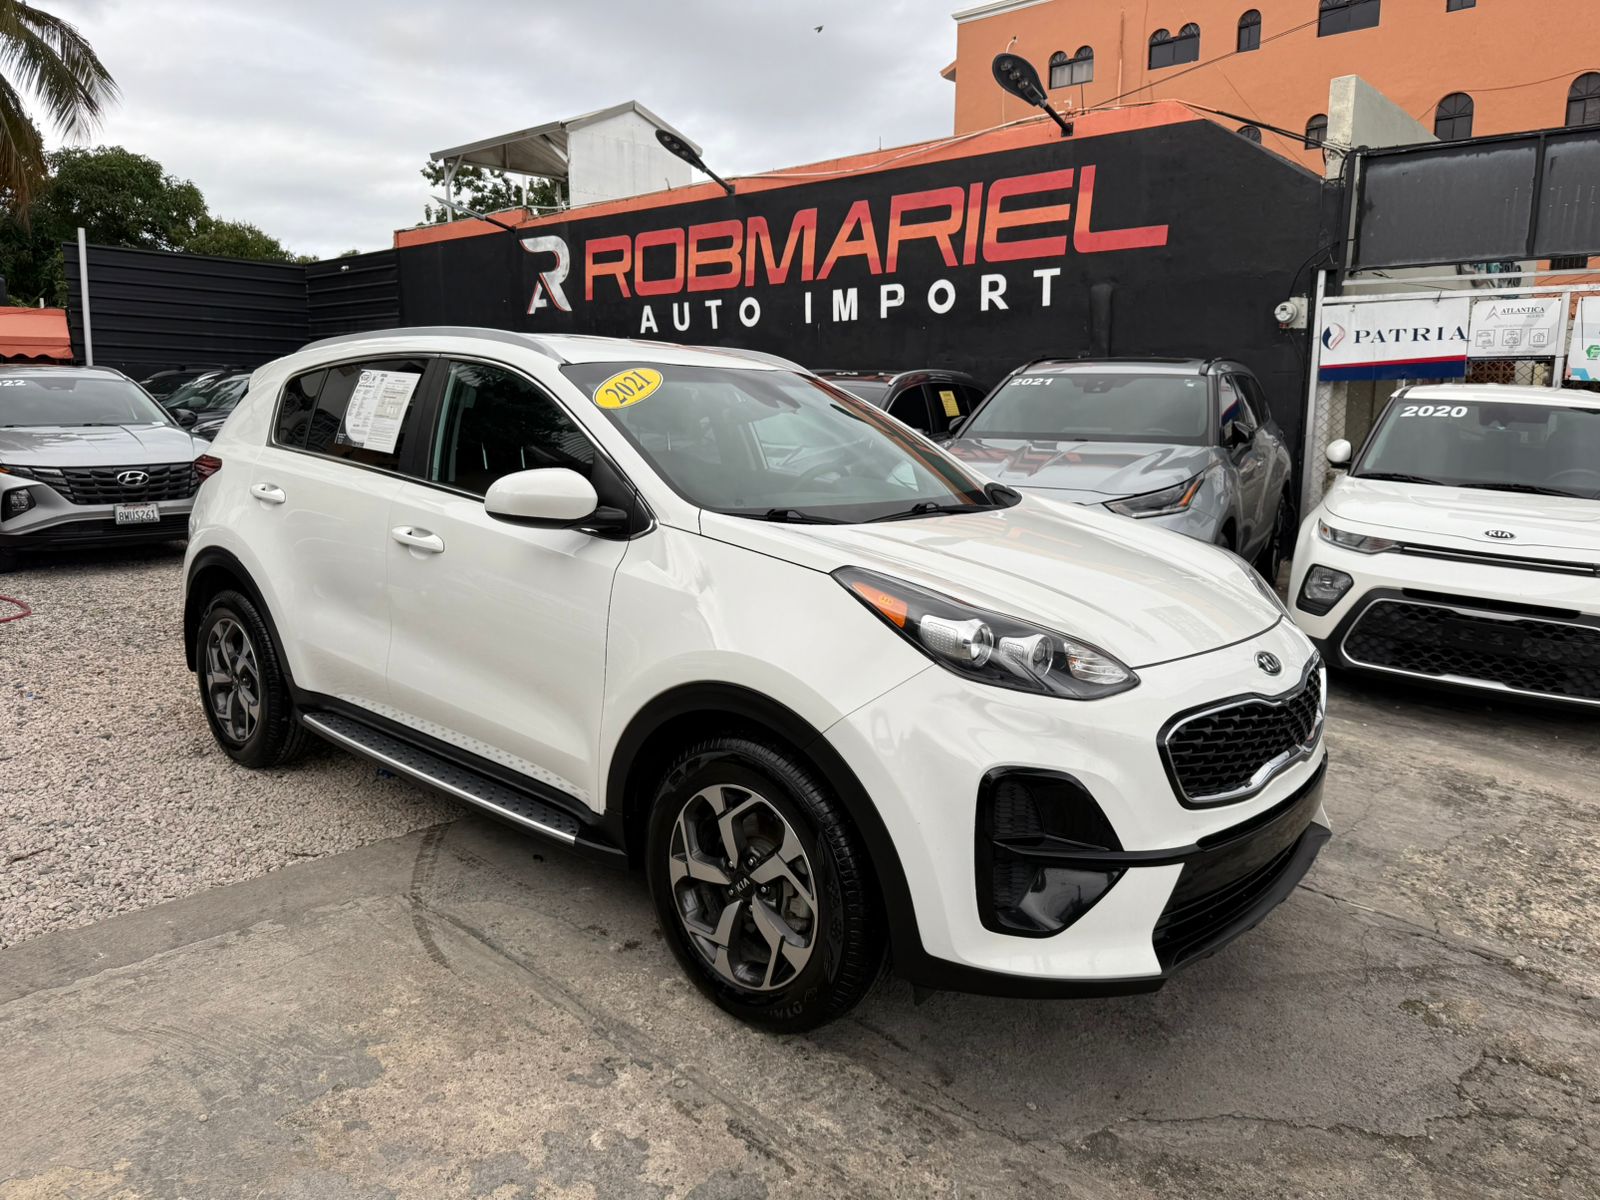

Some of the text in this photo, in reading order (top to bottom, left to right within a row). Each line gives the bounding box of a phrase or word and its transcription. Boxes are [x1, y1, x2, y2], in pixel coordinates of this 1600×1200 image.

[585, 164, 1169, 301] ROBMARIEL
[640, 267, 1061, 334] AUTO IMPORT
[1353, 326, 1467, 344] PATRIA
[605, 371, 653, 404] 2021
[1010, 377, 1054, 386] 2021
[1399, 405, 1468, 418] 2020
[1488, 530, 1511, 538] KIA
[735, 877, 750, 893] KIA
